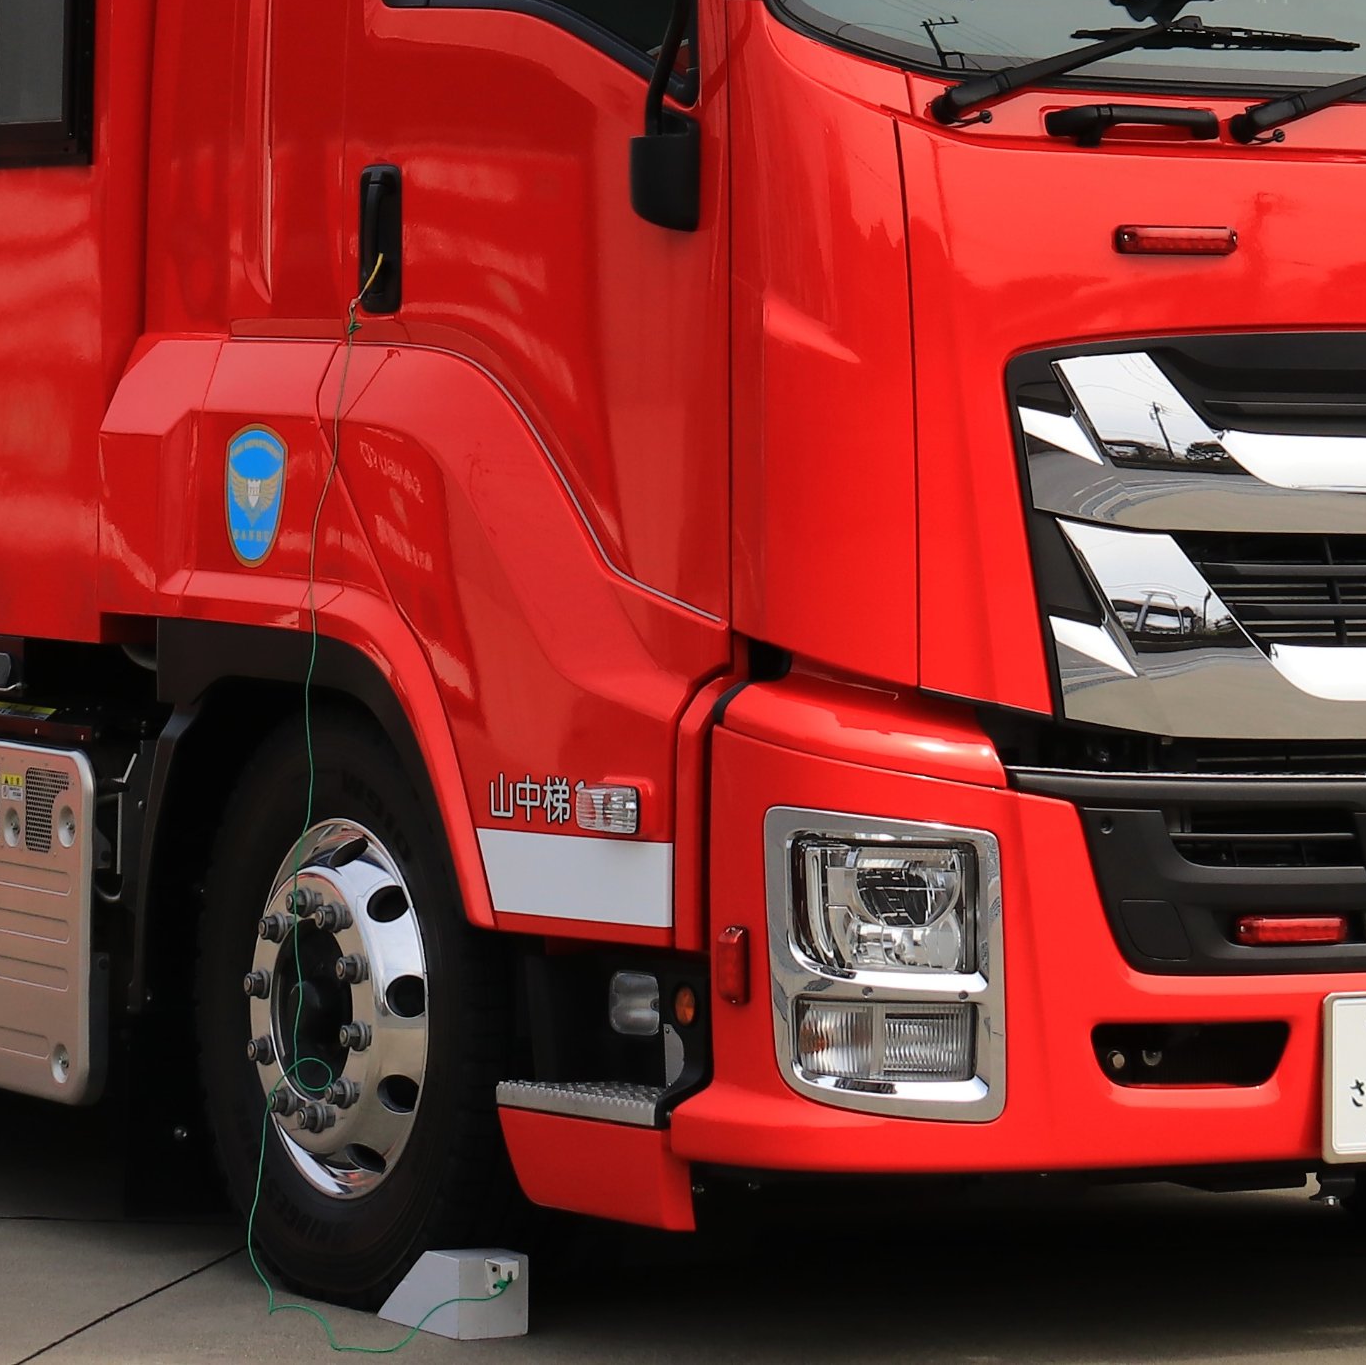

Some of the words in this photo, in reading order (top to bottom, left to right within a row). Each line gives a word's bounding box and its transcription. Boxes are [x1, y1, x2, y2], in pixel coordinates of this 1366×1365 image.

[489, 771, 585, 824] 山中梯
[1350, 1078, 1366, 1108] さ
